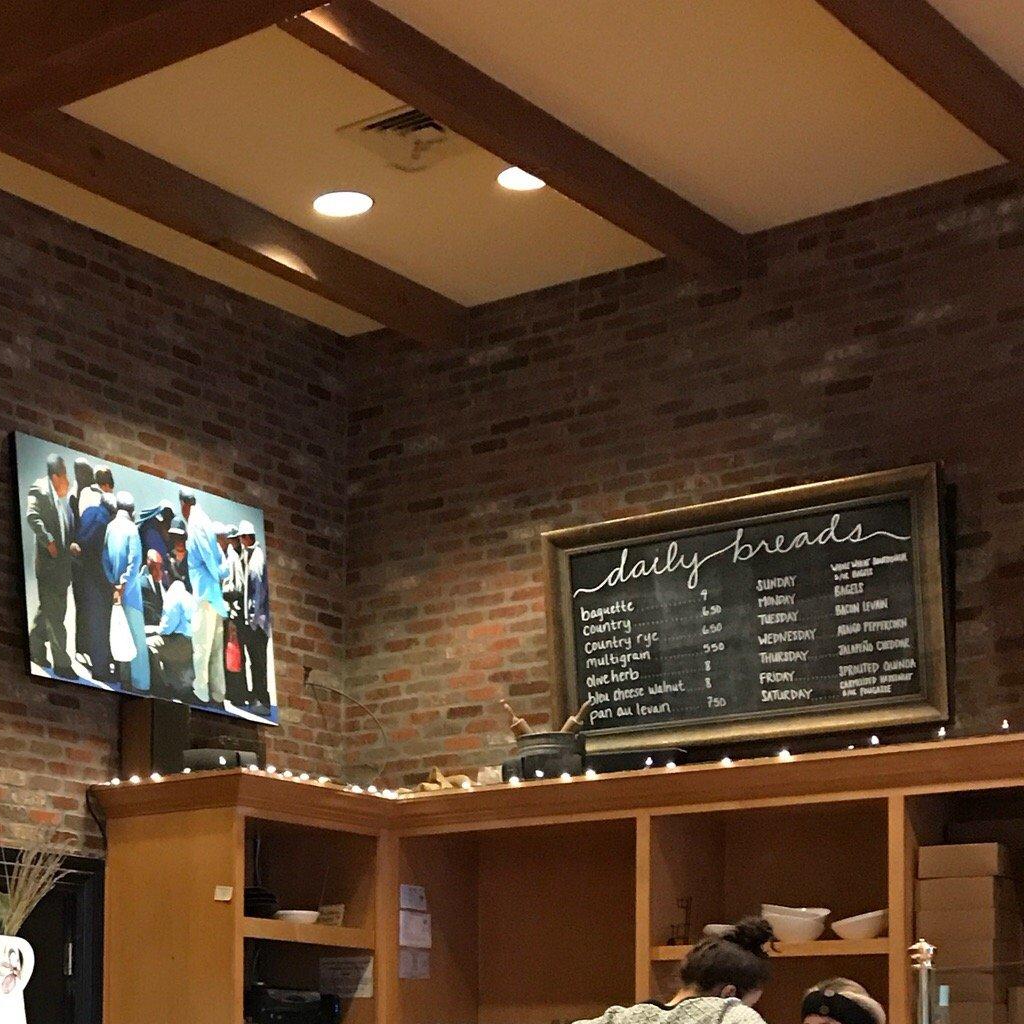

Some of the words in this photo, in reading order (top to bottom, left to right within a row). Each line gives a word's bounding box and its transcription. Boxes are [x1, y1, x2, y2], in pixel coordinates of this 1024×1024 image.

[601, 541, 704, 590] daily
[731, 513, 870, 564] breads
[756, 575, 797, 592] SUNDAY
[757, 593, 796, 608] MONDAY
[834, 582, 864, 598] BAGELS
[580, 600, 635, 622] baguette
[757, 610, 799, 625] TUESDAY
[582, 619, 632, 637] country
[757, 628, 817, 645] WEDNESDAY
[584, 636, 632, 654] country
[636, 632, 659, 647] rye
[585, 650, 651, 669] multigrain
[758, 650, 809, 664] THURSDAY
[611, 667, 640, 683] herb
[759, 671, 795, 684] FRIDAY
[648, 680, 686, 695] walnut
[761, 688, 813, 702] SATURDAY
[589, 707, 613, 726] pan
[616, 705, 633, 717] au
[636, 702, 671, 716] levain
